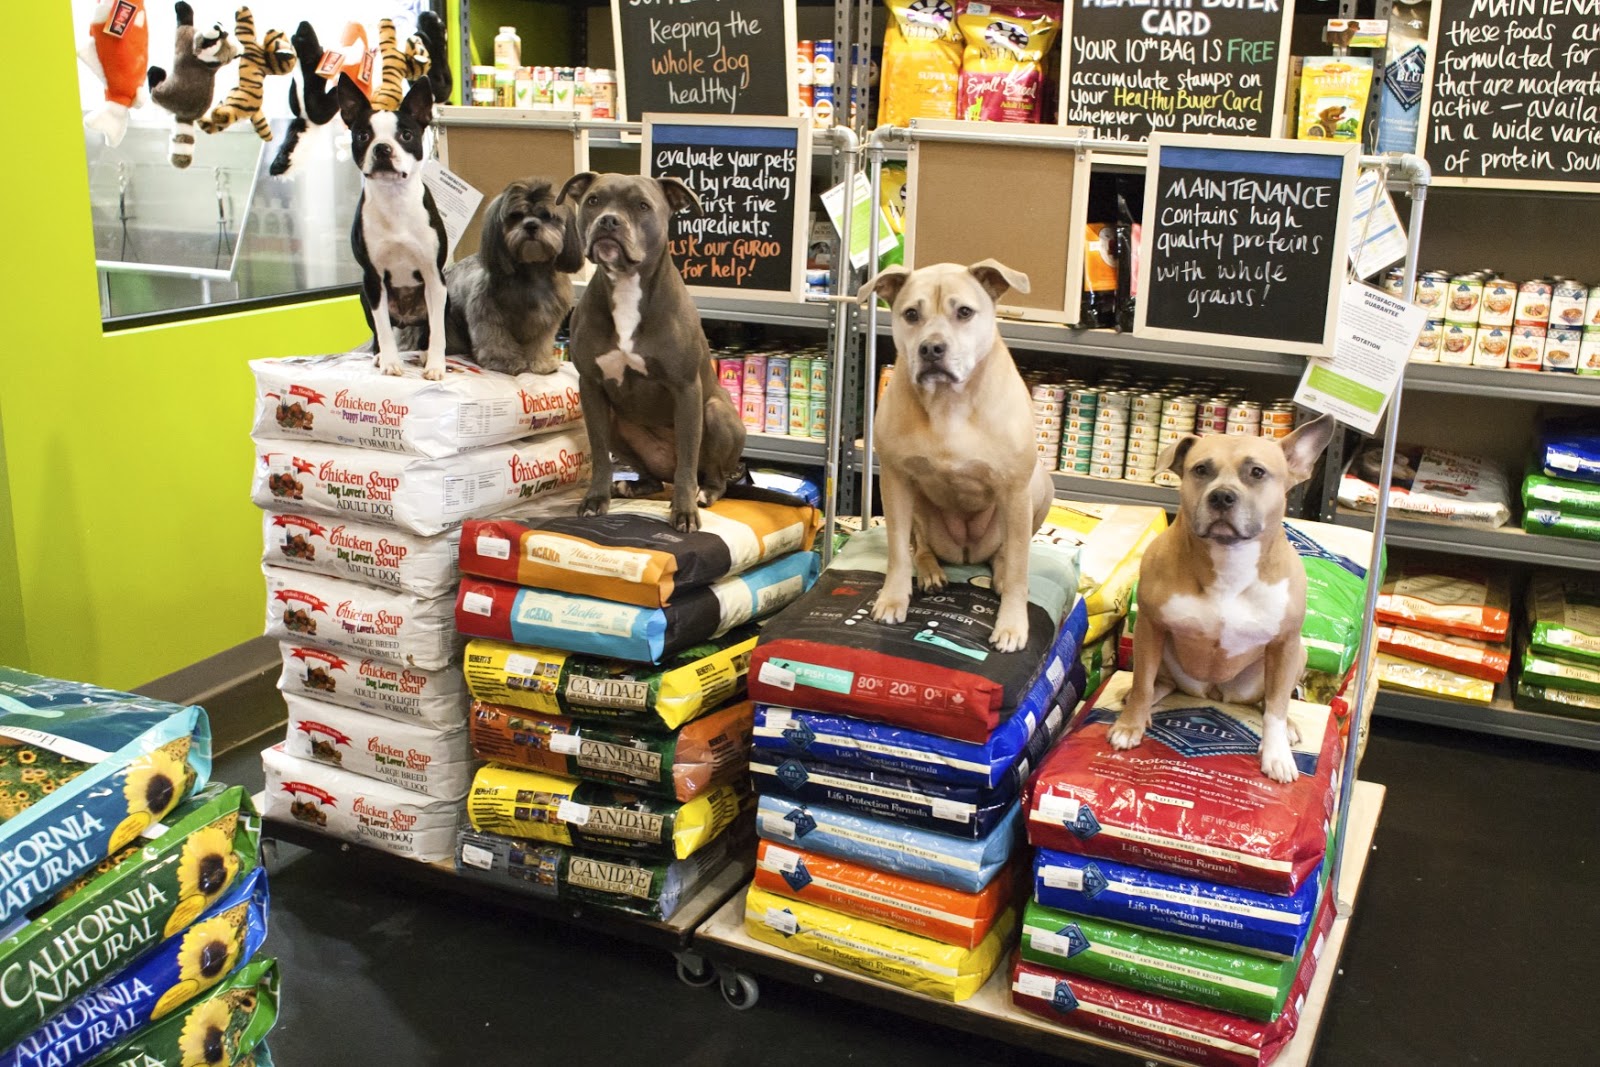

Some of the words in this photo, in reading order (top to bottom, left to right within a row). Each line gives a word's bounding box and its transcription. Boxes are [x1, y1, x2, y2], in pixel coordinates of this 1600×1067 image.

[650, 16, 720, 57] Keeping
[724, 10, 762, 37] the
[1141, 10, 1211, 36] CARD
[1445, 21, 1500, 47] these
[1505, 18, 1556, 45] foods
[1073, 36, 1119, 64] YOUR
[1160, 40, 1196, 64] BAG
[1203, 39, 1222, 63] IS
[1228, 38, 1275, 65] FREE
[1438, 43, 1553, 74] formulated
[1562, 43, 1600, 68] for
[652, 49, 705, 75] whole
[713, 45, 749, 89] dog
[1072, 69, 1171, 91] accumulate
[1177, 69, 1233, 93] stamps
[1239, 73, 1262, 89] on
[1396, 71, 1425, 83] BLU
[669, 73, 746, 114] healthy!
[966, 74, 1001, 97] Small
[1435, 71, 1481, 97] that
[1483, 78, 1514, 96] are
[1070, 87, 1108, 112] your
[1113, 87, 1174, 115] Healthy
[1177, 90, 1222, 115] Buyer
[1223, 89, 1263, 113] Card
[1432, 97, 1494, 119] active
[1069, 105, 1142, 126] whenever
[1146, 111, 1175, 132] you
[1182, 110, 1257, 133] purchase
[1435, 120, 1456, 144] in
[1463, 122, 1480, 141] a
[1492, 117, 1544, 142] wide
[656, 146, 724, 170] evaluate
[728, 151, 762, 176] your
[764, 149, 796, 175] pet's
[1444, 149, 1470, 173] of
[1481, 146, 1555, 176] protein
[701, 170, 719, 198] by
[723, 169, 790, 200] reading
[1165, 177, 1332, 210] MAINTENANCE
[743, 195, 777, 213] five
[678, 213, 773, 244] ingredients.
[1161, 203, 1239, 227] contains
[1250, 205, 1302, 235] high
[668, 235, 702, 257] ask
[704, 241, 732, 256] our
[733, 239, 781, 259] GUROO
[1157, 229, 1223, 259] quality
[1233, 233, 1323, 256] proteins
[681, 259, 708, 279] for
[711, 257, 756, 285] help!
[1157, 261, 1206, 282] with
[1218, 260, 1287, 282] whole
[1188, 284, 1271, 318] grains!
[1364, 291, 1406, 312] SATISFACTION
[1364, 300, 1399, 318] GUARANTEE
[1352, 334, 1381, 350] ROTATION
[334, 389, 377, 412] Chicken
[378, 399, 409, 418] Soup
[517, 389, 564, 414] Chicken
[372, 427, 404, 441] PUPPY
[378, 413, 400, 427] Soul
[318, 460, 364, 486] Chicken
[366, 471, 399, 490] Soup
[508, 454, 557, 484] Chicken
[559, 449, 584, 474] Soup
[336, 500, 369, 513] ADULT
[371, 501, 394, 516] DOG
[367, 488, 392, 501] Soul
[329, 525, 372, 552] Chicken
[375, 539, 407, 560] Soup
[375, 554, 399, 568] Soul
[378, 569, 400, 582] DOG
[375, 610, 403, 630] Soup
[375, 623, 397, 636] Soul
[359, 658, 397, 681] Chicken
[399, 669, 427, 688] Soup
[803, 668, 825, 680] FISH
[1565, 667, 1592, 679] Prairie
[399, 682, 421, 695] Soul
[857, 676, 884, 690] 80%
[889, 682, 917, 696] 20%
[924, 687, 943, 700] 0%
[384, 702, 423, 717] FORMULA
[1165, 718, 1237, 741] BLUE
[367, 736, 404, 758] Chicken
[406, 748, 431, 767] Soup
[580, 741, 658, 769] CANIDAE
[401, 771, 428, 783] BREED
[352, 797, 388, 819] Chicken
[390, 809, 417, 827] Soup
[827, 790, 845, 801] Life
[846, 793, 889, 810] Protection
[891, 802, 928, 817] Formula
[357, 824, 388, 840] SENIOR
[590, 809, 660, 832] ANIDAE
[0, 810, 105, 889] IFORNIA
[1122, 843, 1139, 853] Life
[1143, 847, 1194, 866] Protection
[1196, 859, 1238, 874] Formula
[571, 860, 649, 888] CANIDAE
[1128, 900, 1147, 911] Life
[1150, 902, 1199, 922] Protection
[1202, 914, 1244, 930] Formula
[0, 882, 168, 1009] CALIFORNIA
[833, 947, 874, 968] Protection
[34, 916, 158, 1019] NATURAL
[1108, 962, 1127, 973] Life
[1129, 967, 1178, 987] Protection
[1180, 979, 1221, 997] Formula
[13, 977, 155, 1067] ALIFORNIA
[1118, 1025, 1165, 1046] Protection
[1167, 1039, 1208, 1056] Formula
